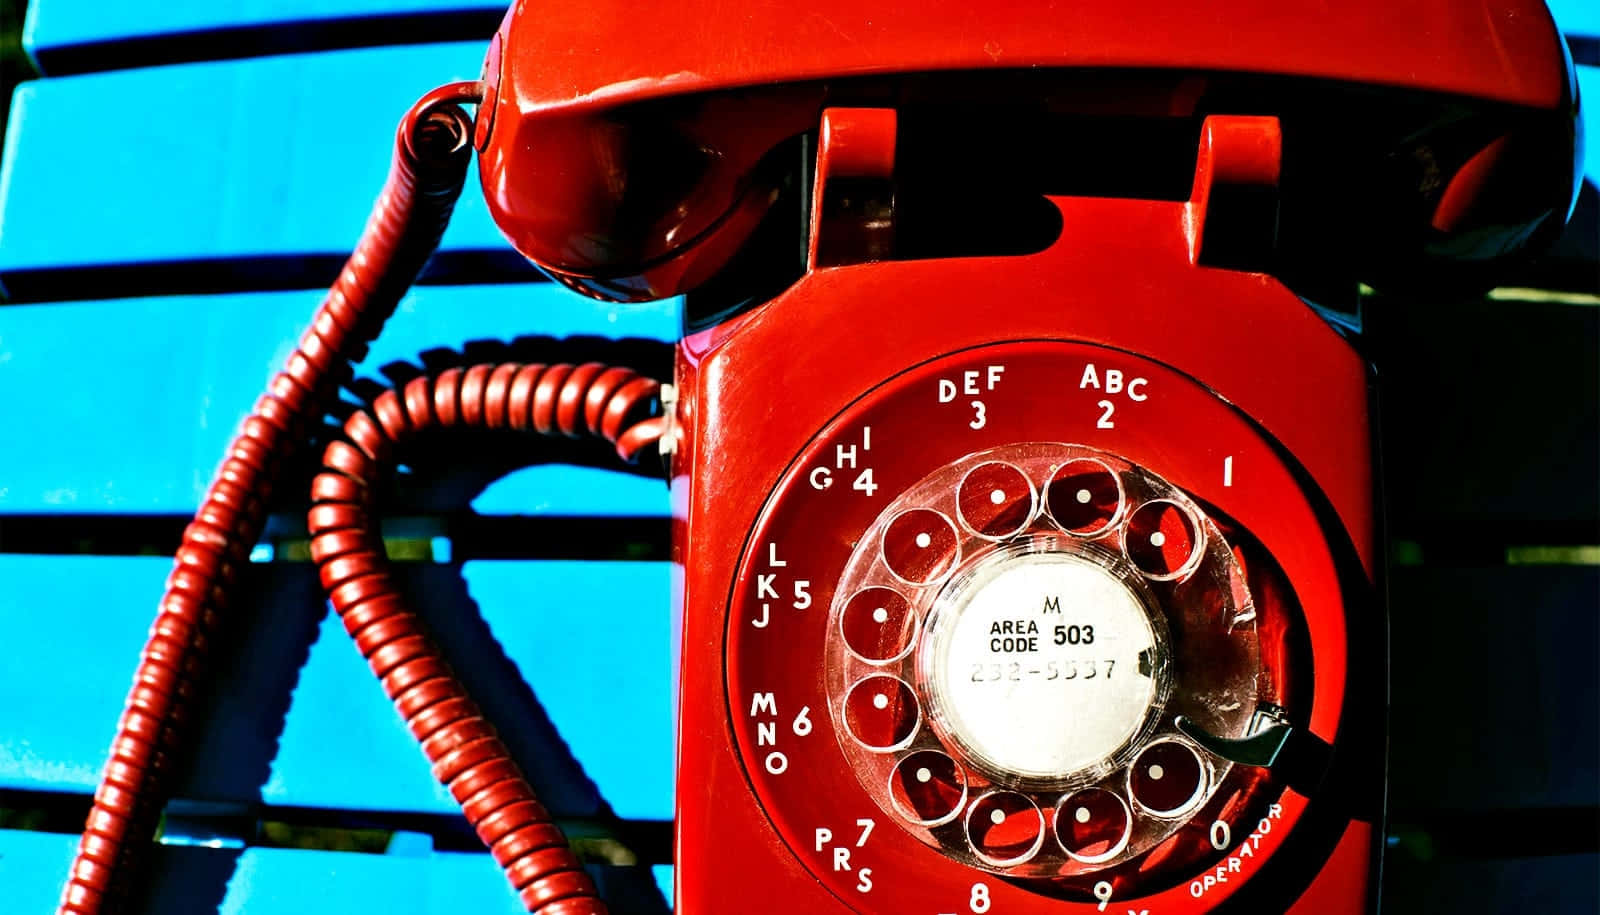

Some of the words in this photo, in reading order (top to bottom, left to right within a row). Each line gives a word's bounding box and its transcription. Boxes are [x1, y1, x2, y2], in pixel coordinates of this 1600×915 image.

[938, 366, 1005, 403] DEF
[1079, 364, 1148, 402] ABC
[969, 401, 987, 429] 3
[1097, 400, 1115, 429] 2
[852, 469, 878, 497] 4
[793, 580, 812, 610] 5
[1043, 596, 1062, 615] M
[990, 620, 1040, 635] AREA
[1054, 625, 1095, 646] 503
[990, 637, 1039, 653] CODE
[792, 705, 813, 737] 6
[856, 818, 876, 847] 7
[1190, 803, 1283, 898] OPERATOR
[969, 882, 991, 914] 8
[1093, 880, 1113, 912] 9
